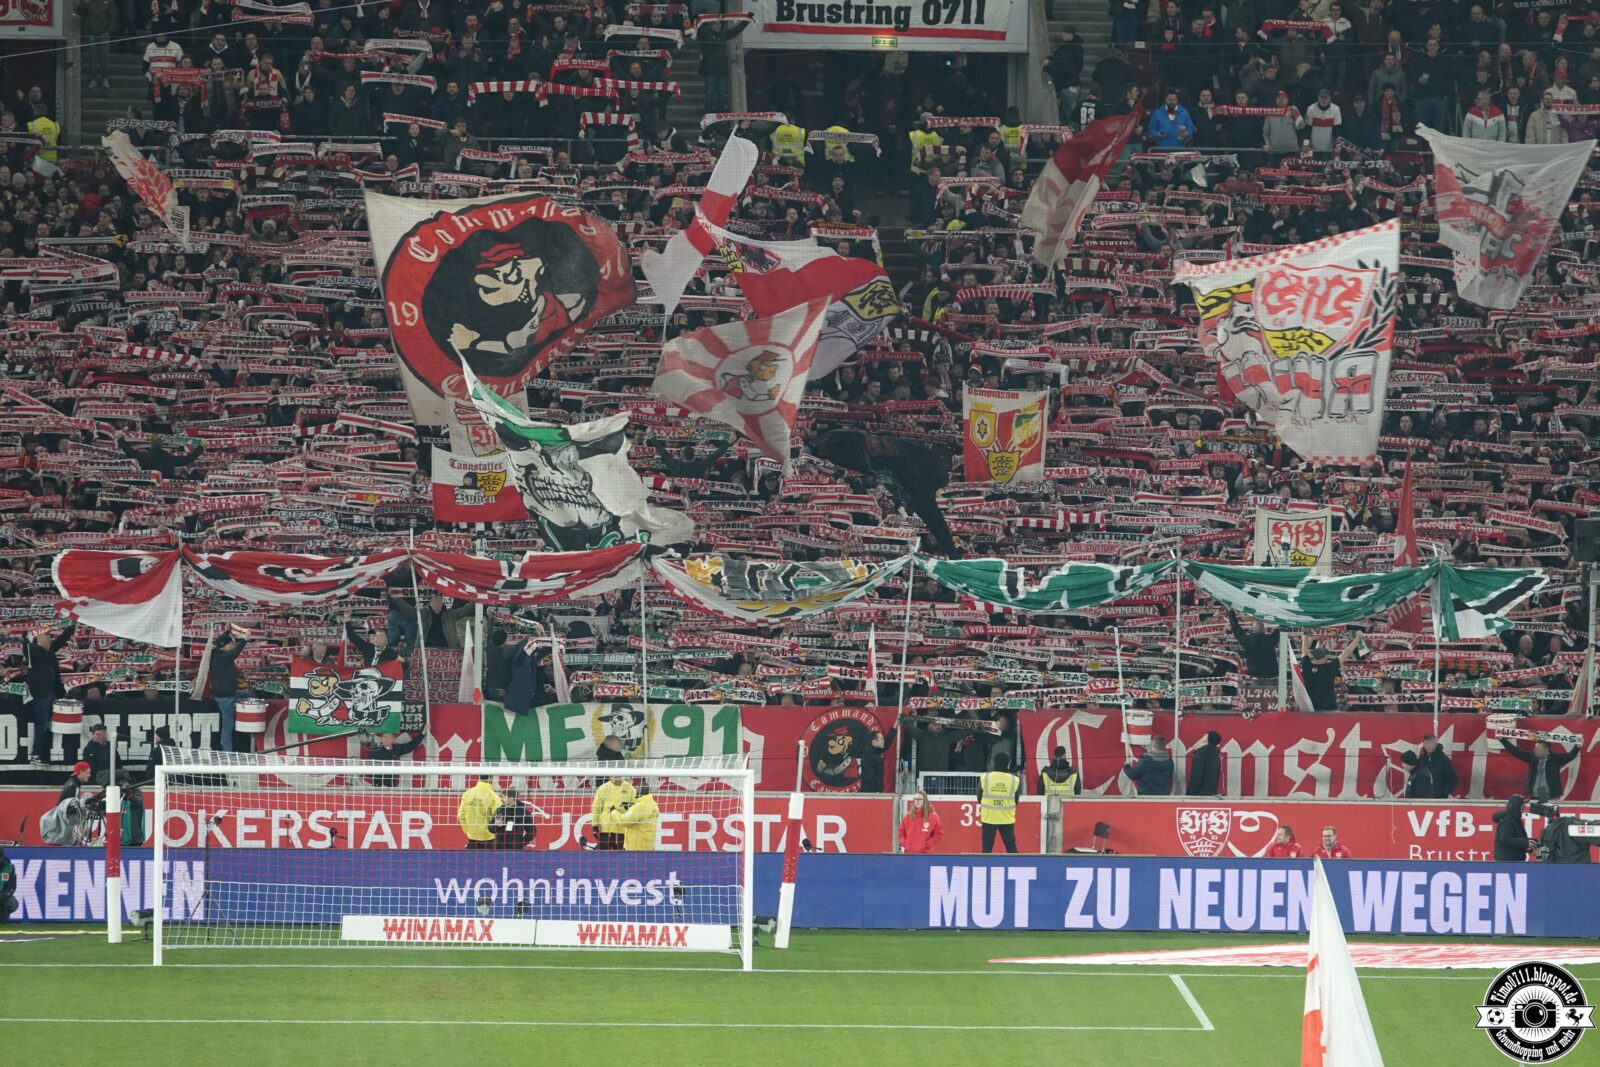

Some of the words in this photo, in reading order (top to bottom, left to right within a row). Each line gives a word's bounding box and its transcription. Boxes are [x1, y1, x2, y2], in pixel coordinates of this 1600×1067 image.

[776, 0, 911, 32] Brustring
[921, 0, 986, 25] 0711
[739, 690, 764, 701] RAS
[484, 703, 586, 765] MF
[661, 704, 740, 763] 91
[1552, 735, 1578, 744] RAS
[434, 867, 680, 906] wohninvest
[929, 865, 1037, 930] MUT
[1063, 867, 1130, 929] ZU
[1158, 868, 1315, 932] NEUEN
[1348, 869, 1527, 935] WEGEN
[382, 918, 495, 943] WINAMAX
[576, 921, 690, 947] WINAMAX
